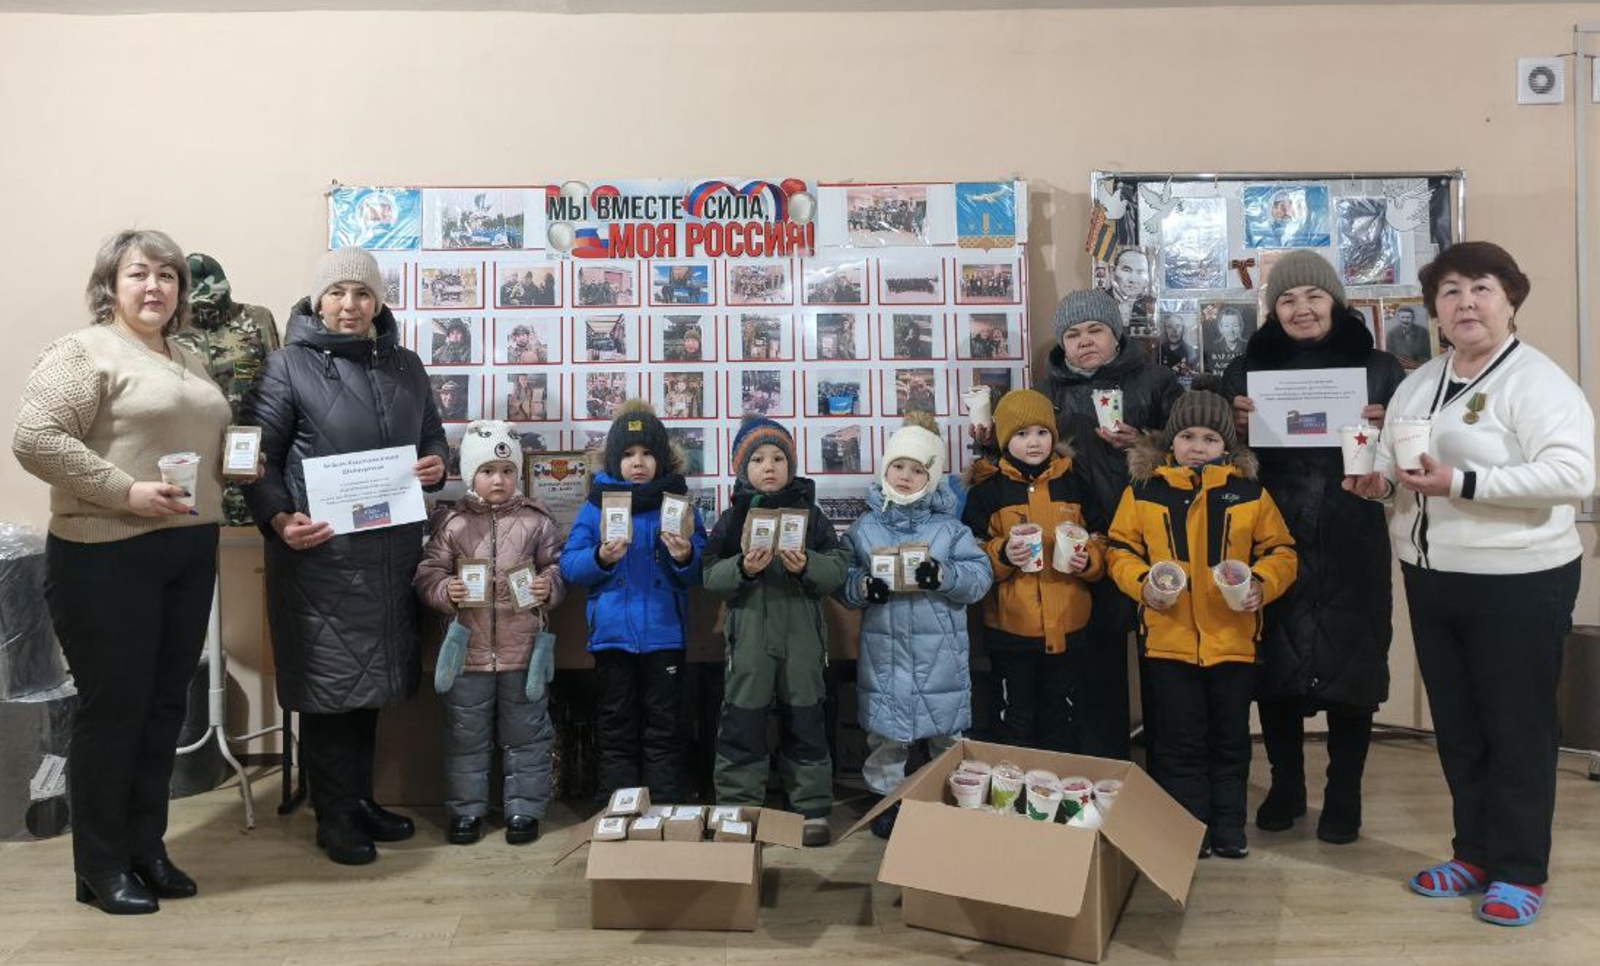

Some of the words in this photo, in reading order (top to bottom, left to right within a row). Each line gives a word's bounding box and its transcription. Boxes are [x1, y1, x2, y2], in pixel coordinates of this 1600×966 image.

[549, 196, 588, 221] МЫ
[597, 195, 683, 220] ВМЕСТЕ
[703, 195, 769, 220] СИЛА,
[609, 222, 675, 259] МОЯ
[685, 222, 815, 258] РОССИЯ!
